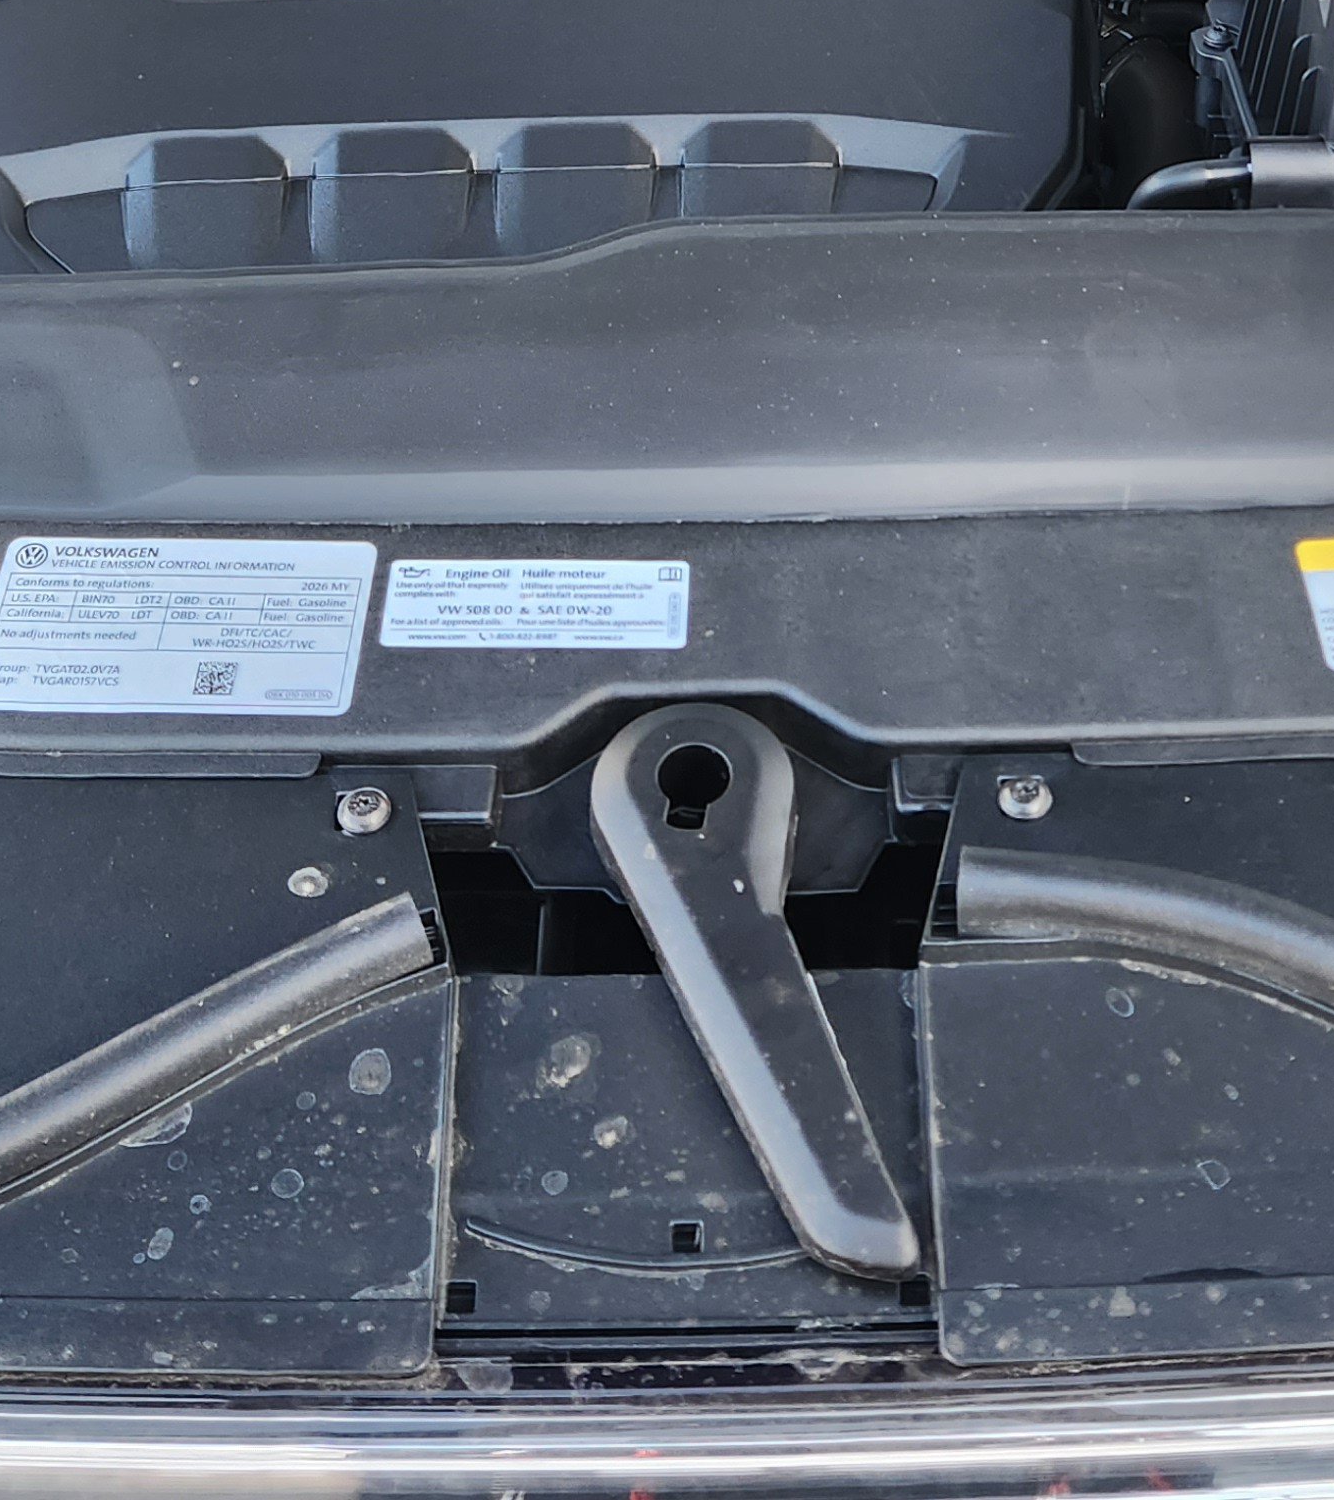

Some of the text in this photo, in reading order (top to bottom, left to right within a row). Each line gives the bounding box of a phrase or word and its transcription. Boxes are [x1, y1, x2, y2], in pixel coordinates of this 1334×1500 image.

[55, 545, 160, 558] VOLKSWAGEN
[51, 560, 296, 572] VEHICLE EMISSION CONTROL INFORMATION
[445, 568, 511, 581] Engine Oil
[522, 568, 606, 579] Huile moteur
[15, 577, 351, 591] Conforms to regulations: 2026 MY
[447, 581, 466, 589] that
[11, 593, 32, 603] U.S.
[81, 595, 116, 604] BIN70
[134, 595, 163, 605] LDT2
[208, 596, 226, 605] CA
[298, 598, 348, 608] Gasoline
[6, 608, 64, 619] California:
[78, 609, 120, 619] ULEV70
[131, 610, 153, 620] LDT
[170, 611, 200, 621] OBD:
[205, 611, 223, 620] CA
[295, 613, 345, 623] Gasoline
[437, 605, 613, 615] VW 508 00 & SAE 0W-20
[0, 628, 137, 643] No adjustments needed
[220, 628, 294, 638] DFI/TC/CAC/
